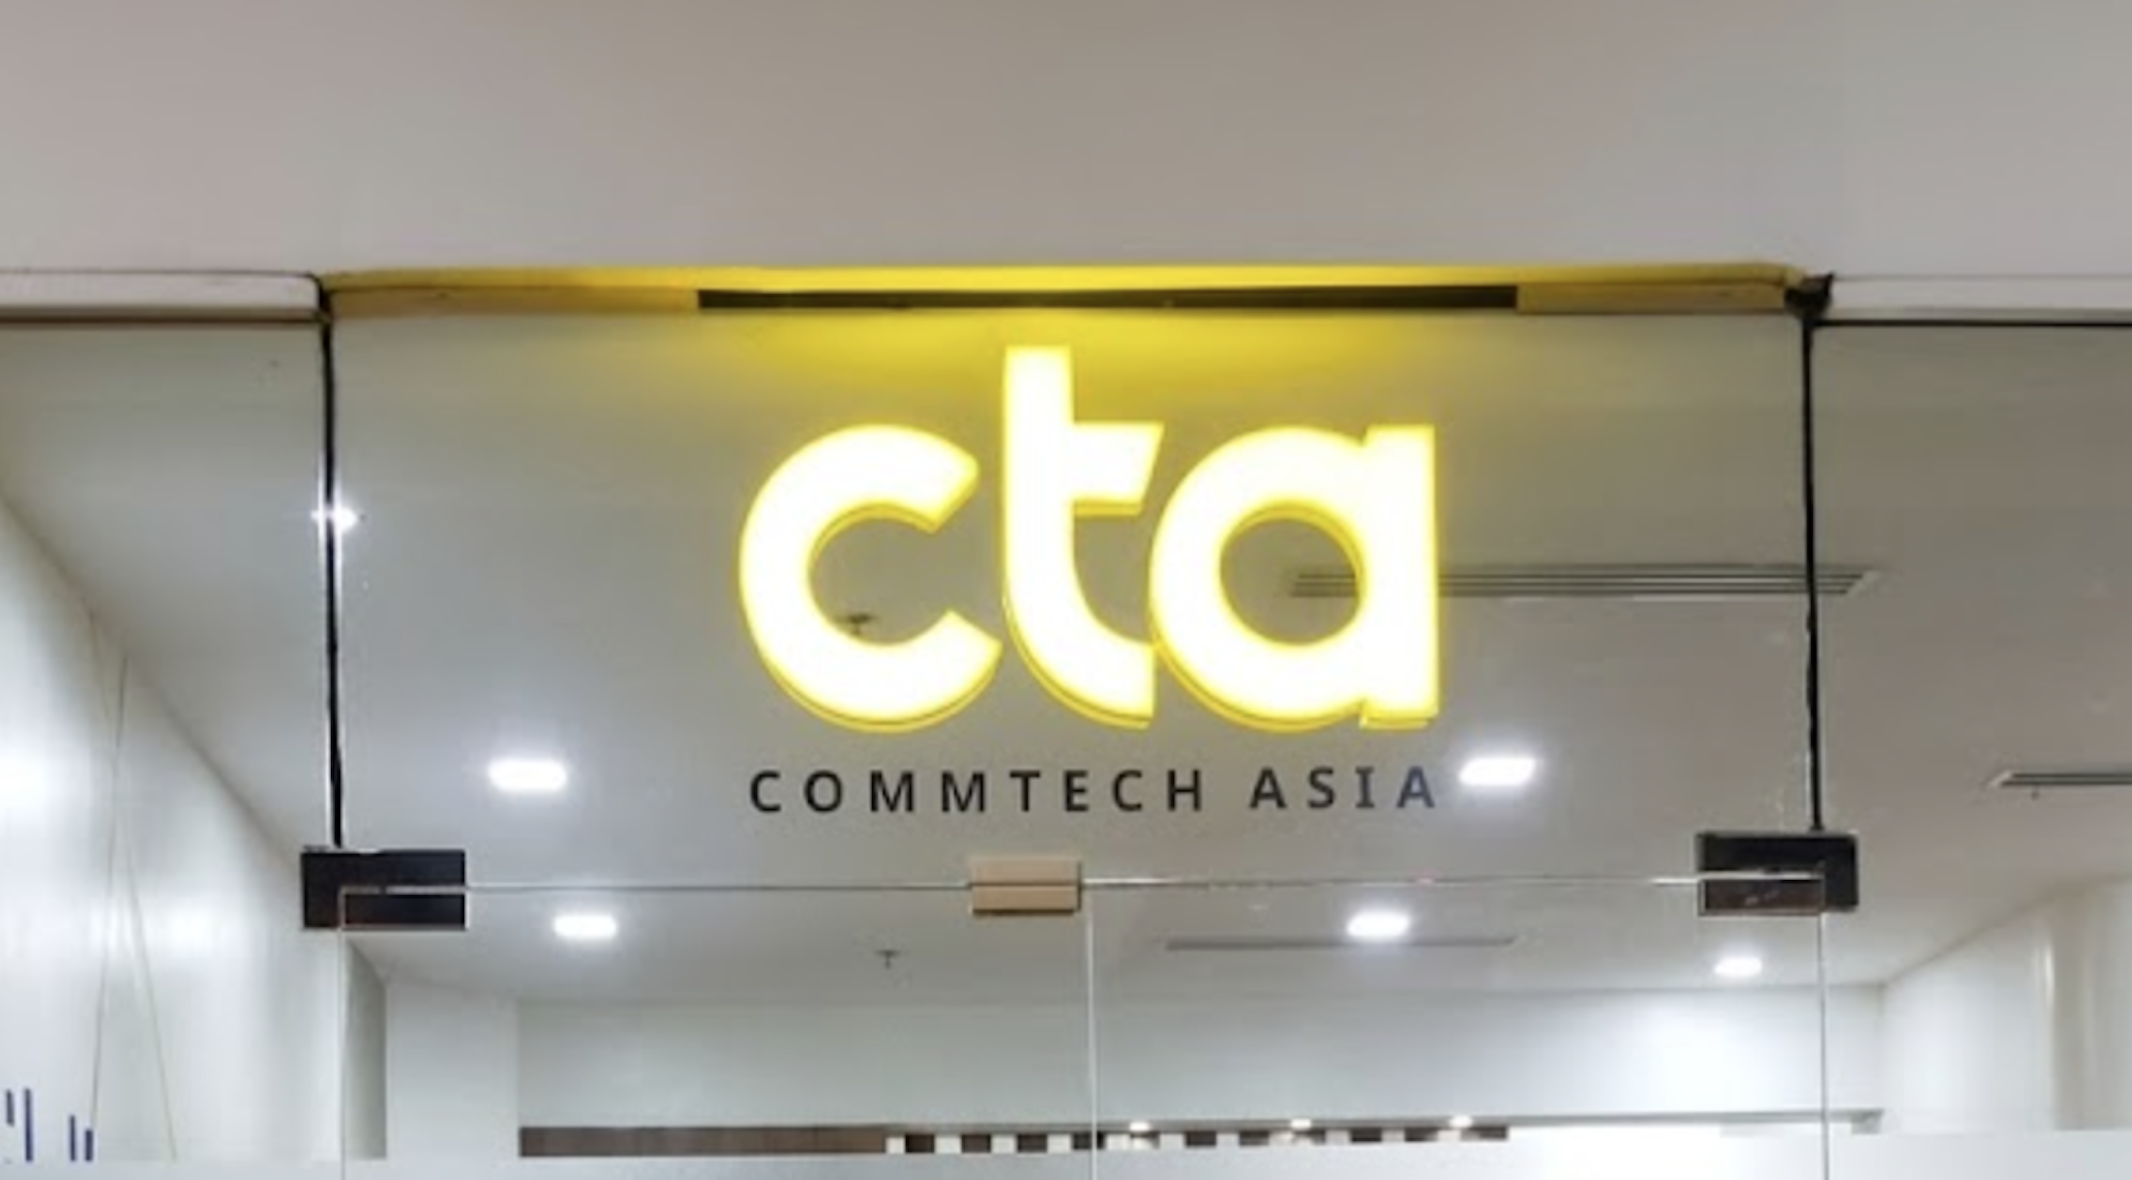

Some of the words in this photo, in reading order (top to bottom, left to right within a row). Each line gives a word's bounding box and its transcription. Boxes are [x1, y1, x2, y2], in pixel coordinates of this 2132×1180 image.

[739, 345, 1440, 733] cta
[749, 769, 1203, 814] COMMTECH
[1248, 766, 1437, 810] ASIA
